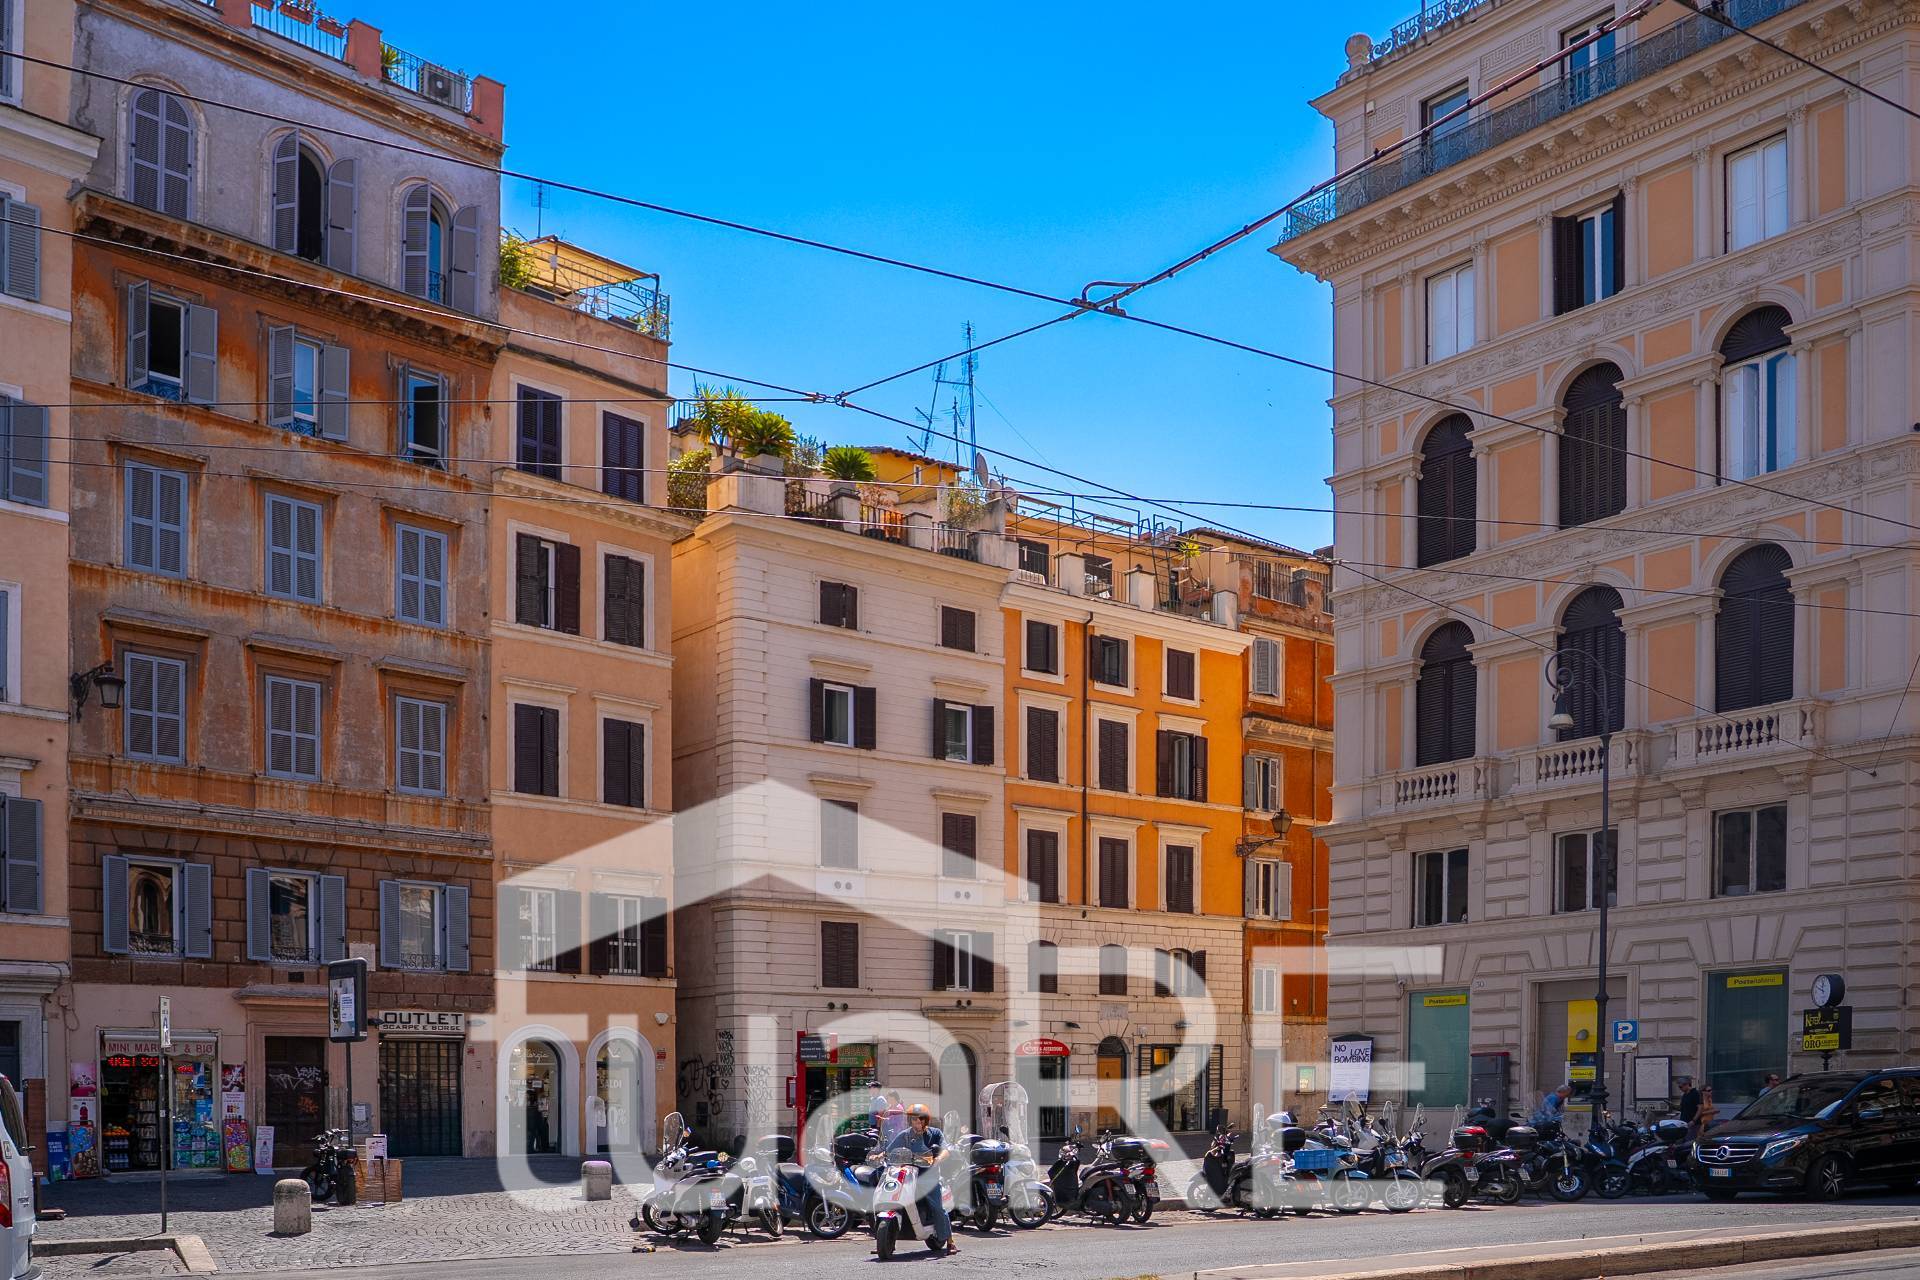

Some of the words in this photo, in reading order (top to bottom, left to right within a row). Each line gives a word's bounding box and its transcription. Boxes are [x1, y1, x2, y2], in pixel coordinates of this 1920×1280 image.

[384, 1012, 463, 1025] OUTLET
[1617, 1022, 1633, 1041] P
[108, 1043, 130, 1053] MINI
[134, 1043, 177, 1053] MARET
[1334, 1044, 1347, 1053] NO
[1350, 1048, 1370, 1056] LOVE
[1334, 1055, 1370, 1063] BOMBING
